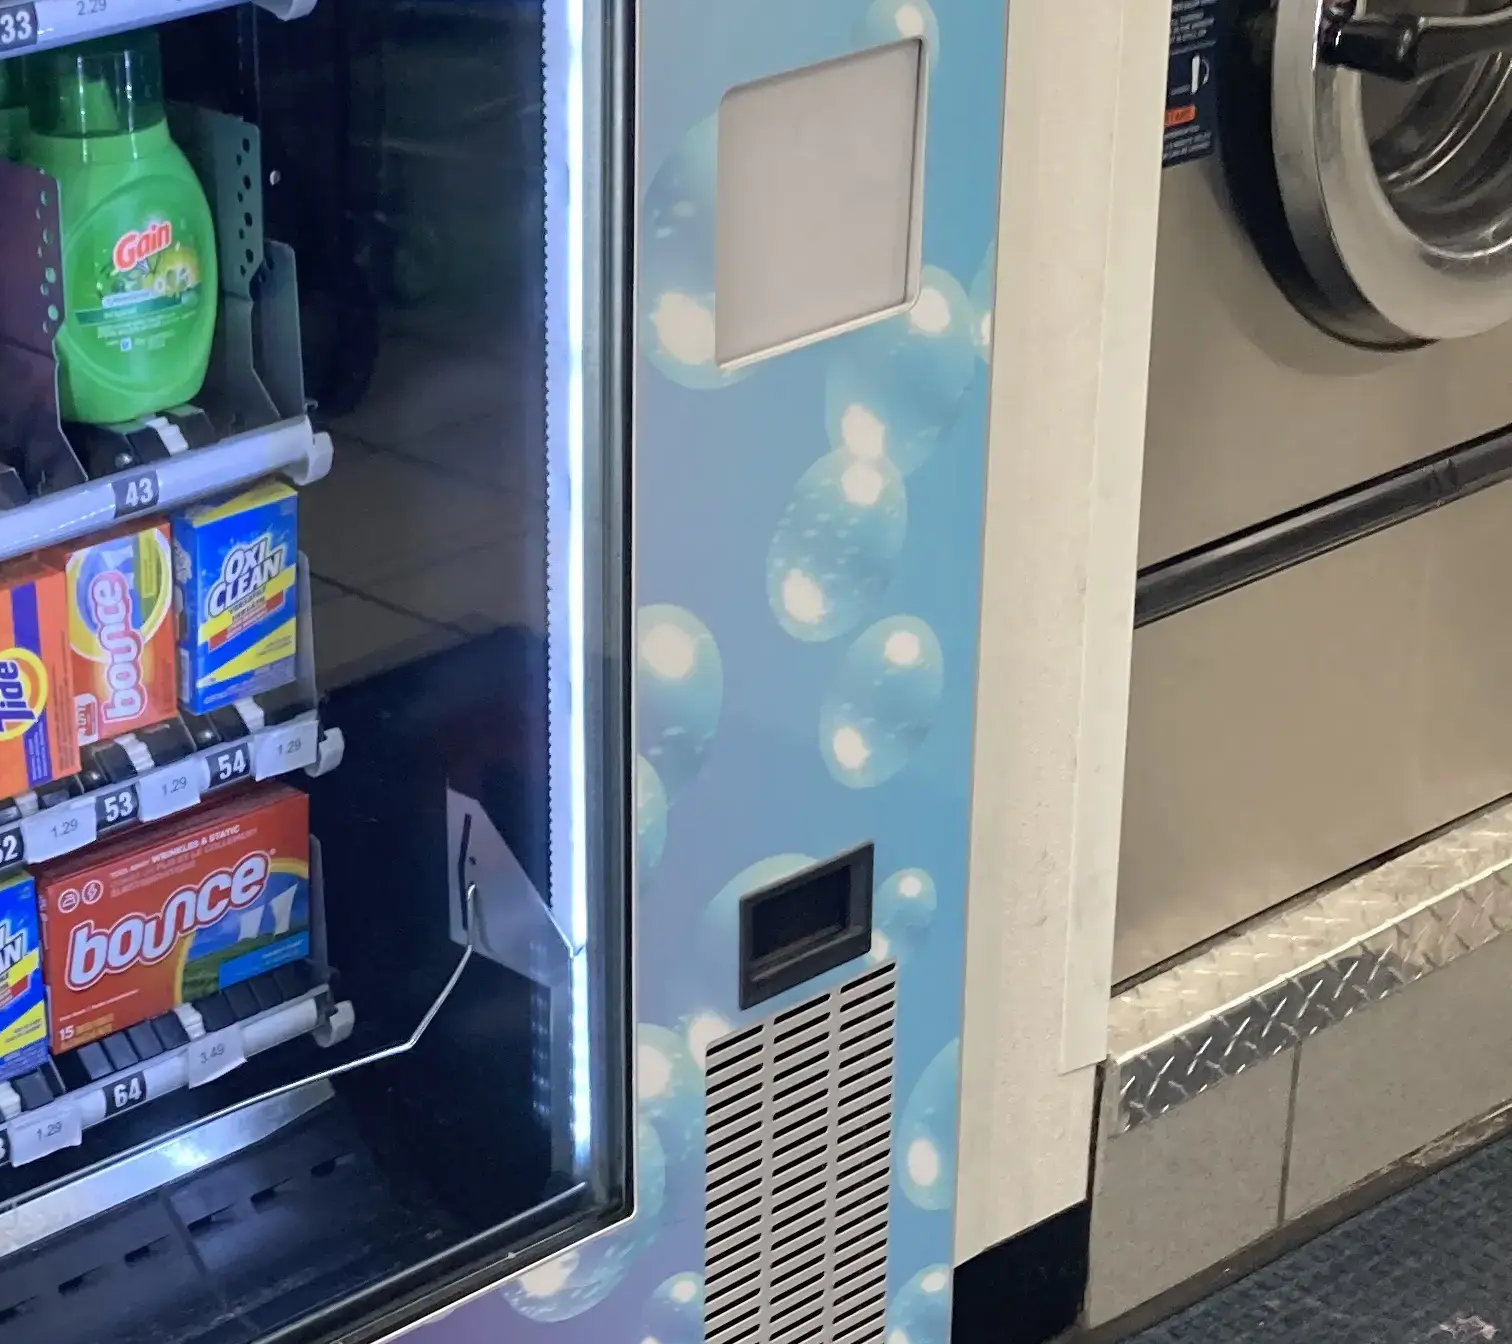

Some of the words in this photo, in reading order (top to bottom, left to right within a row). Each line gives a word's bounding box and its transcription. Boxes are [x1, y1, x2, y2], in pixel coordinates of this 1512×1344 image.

[0, 11, 32, 44] 33
[114, 222, 172, 272] Gain
[125, 478, 154, 507] 43
[225, 536, 268, 584] OXI
[208, 549, 284, 618] CLEAN
[89, 576, 144, 720] bounce
[277, 738, 302, 755] 1.29
[218, 749, 246, 780] 54
[162, 776, 187, 797] 1.29
[104, 791, 133, 823] 53
[51, 818, 78, 839] 1.29
[68, 853, 269, 988] bounce
[59, 1024, 75, 1042] 15
[113, 1077, 142, 1108] 64
[37, 1122, 63, 1141] 1.29
